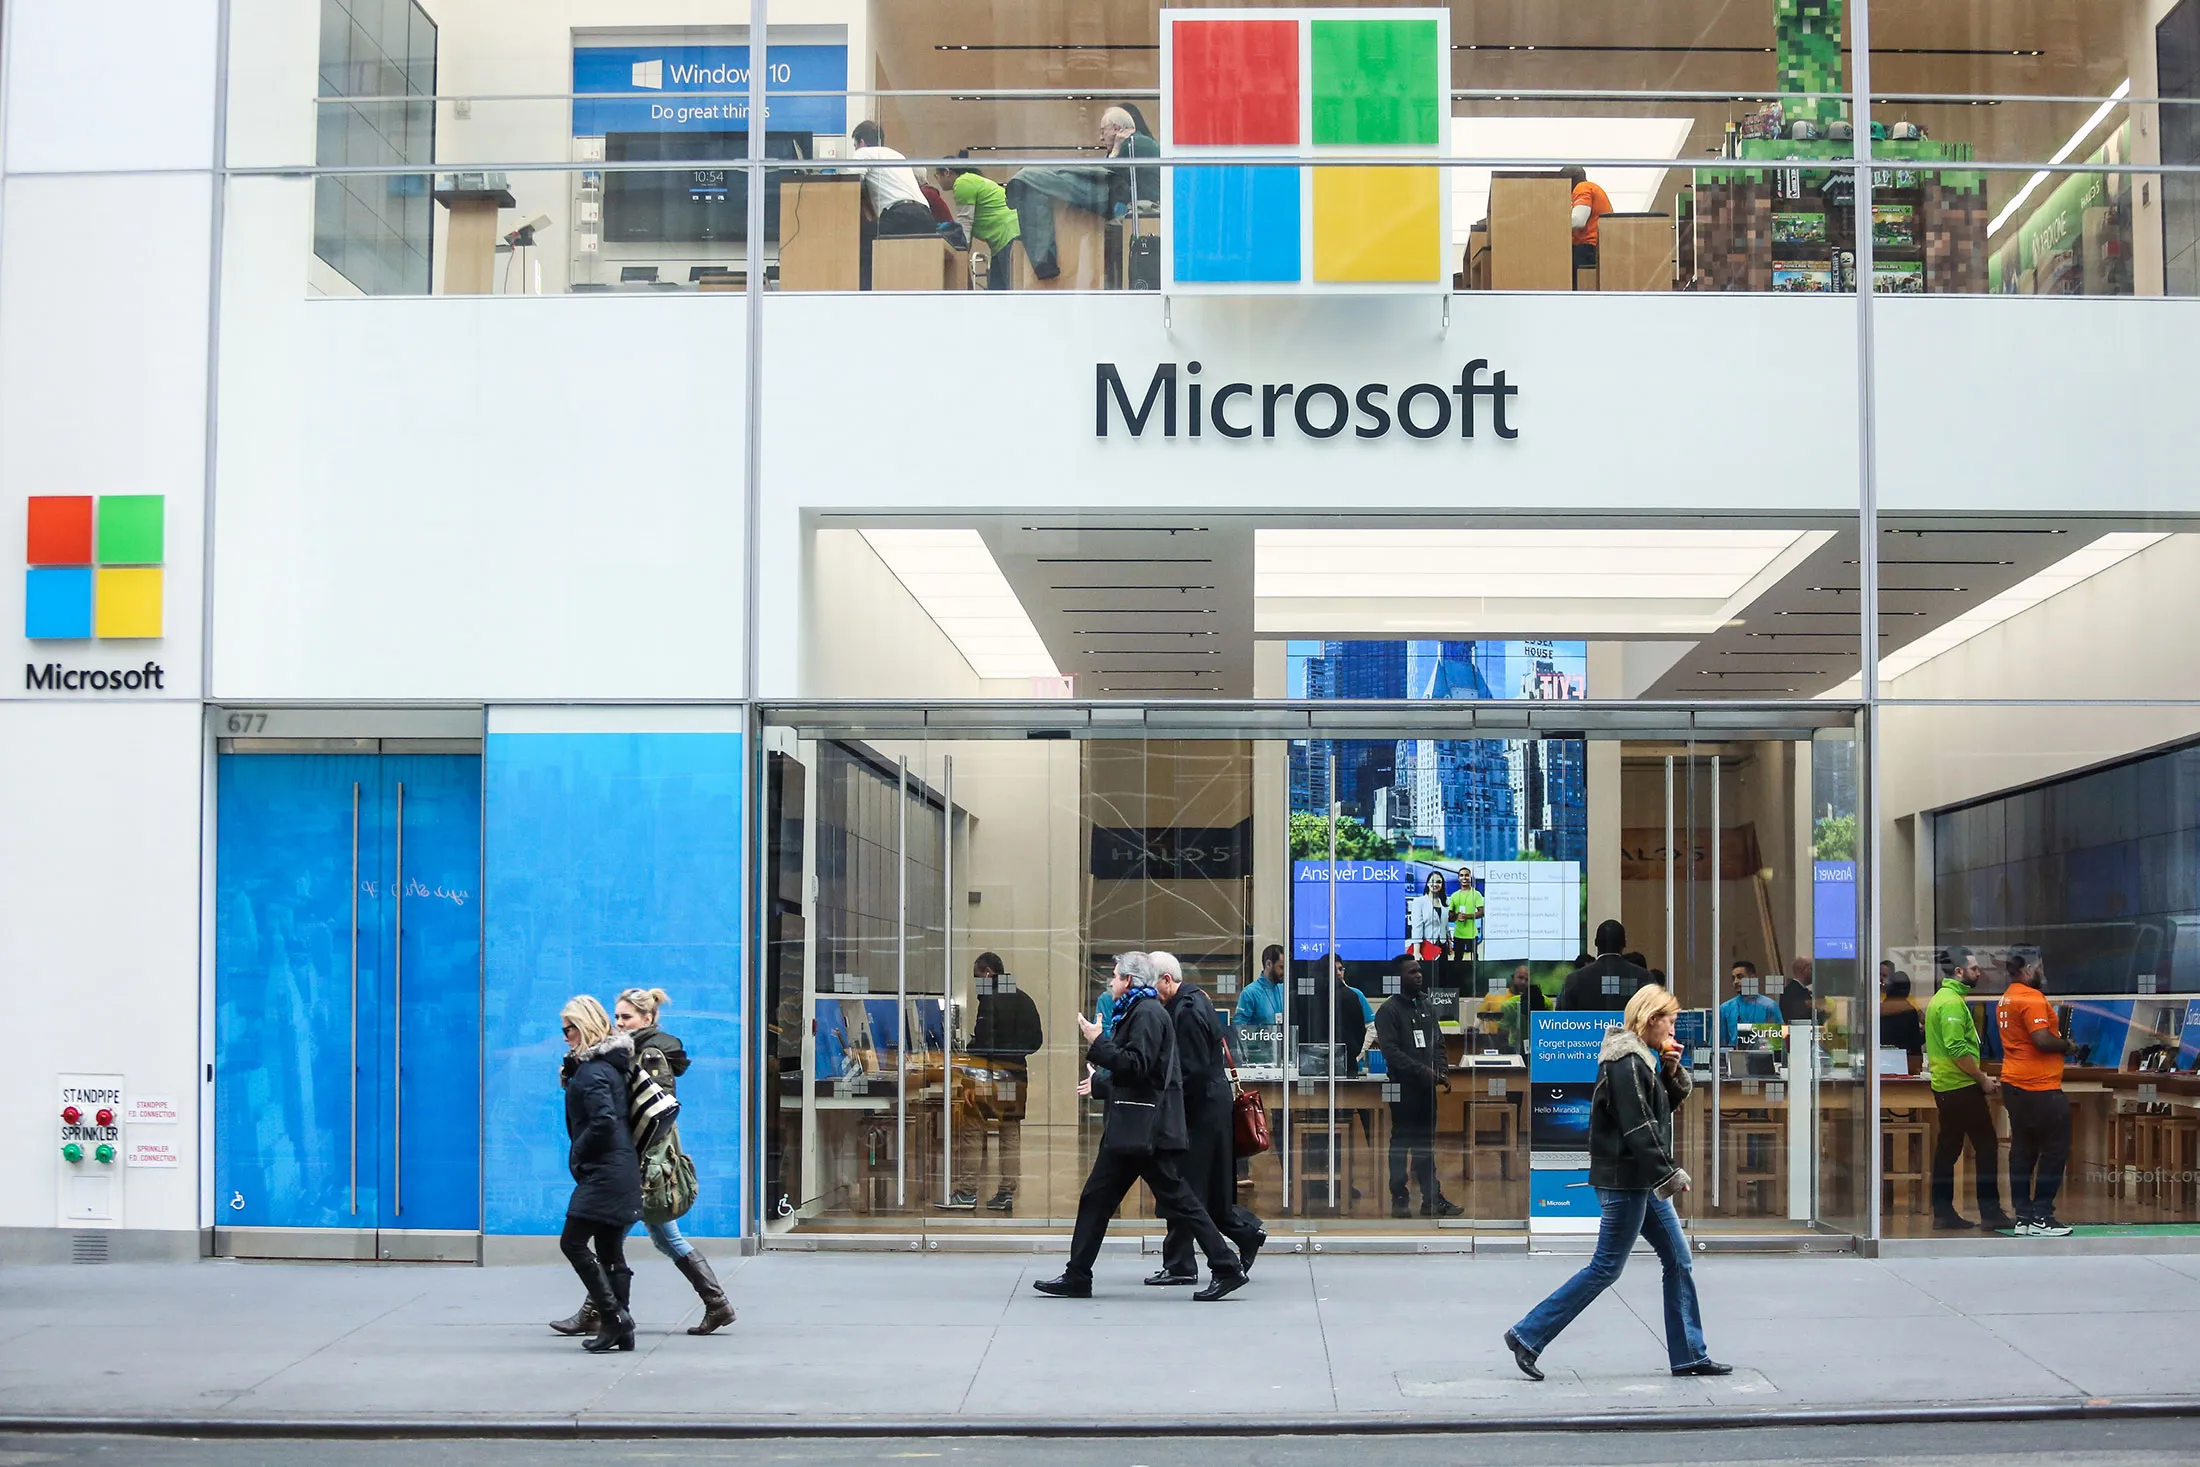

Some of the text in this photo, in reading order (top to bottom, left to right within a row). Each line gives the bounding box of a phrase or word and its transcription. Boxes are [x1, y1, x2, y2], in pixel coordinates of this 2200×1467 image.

[670, 64, 791, 83] Window 10
[652, 104, 770, 122] Do great thins
[694, 171, 724, 183] 10:54
[1095, 358, 1519, 440] Microsoft
[1525, 646, 1553, 659] HOUSE
[26, 661, 164, 690] Microsoft
[227, 713, 268, 734] 677
[1362, 865, 1399, 880] Desk
[1490, 870, 1527, 880] Events
[1538, 1019, 1591, 1030] Windows
[1240, 1028, 1283, 1041] Surface
[1751, 1028, 1783, 1038] Surfac
[1538, 1039, 1602, 1049] Forget passwor
[1539, 1051, 1556, 1061] sign
[1558, 1051, 1565, 1059] in
[1567, 1051, 1584, 1059] with
[63, 1089, 120, 1104] STANDPIPE
[62, 1126, 118, 1141] SPRINKLER
